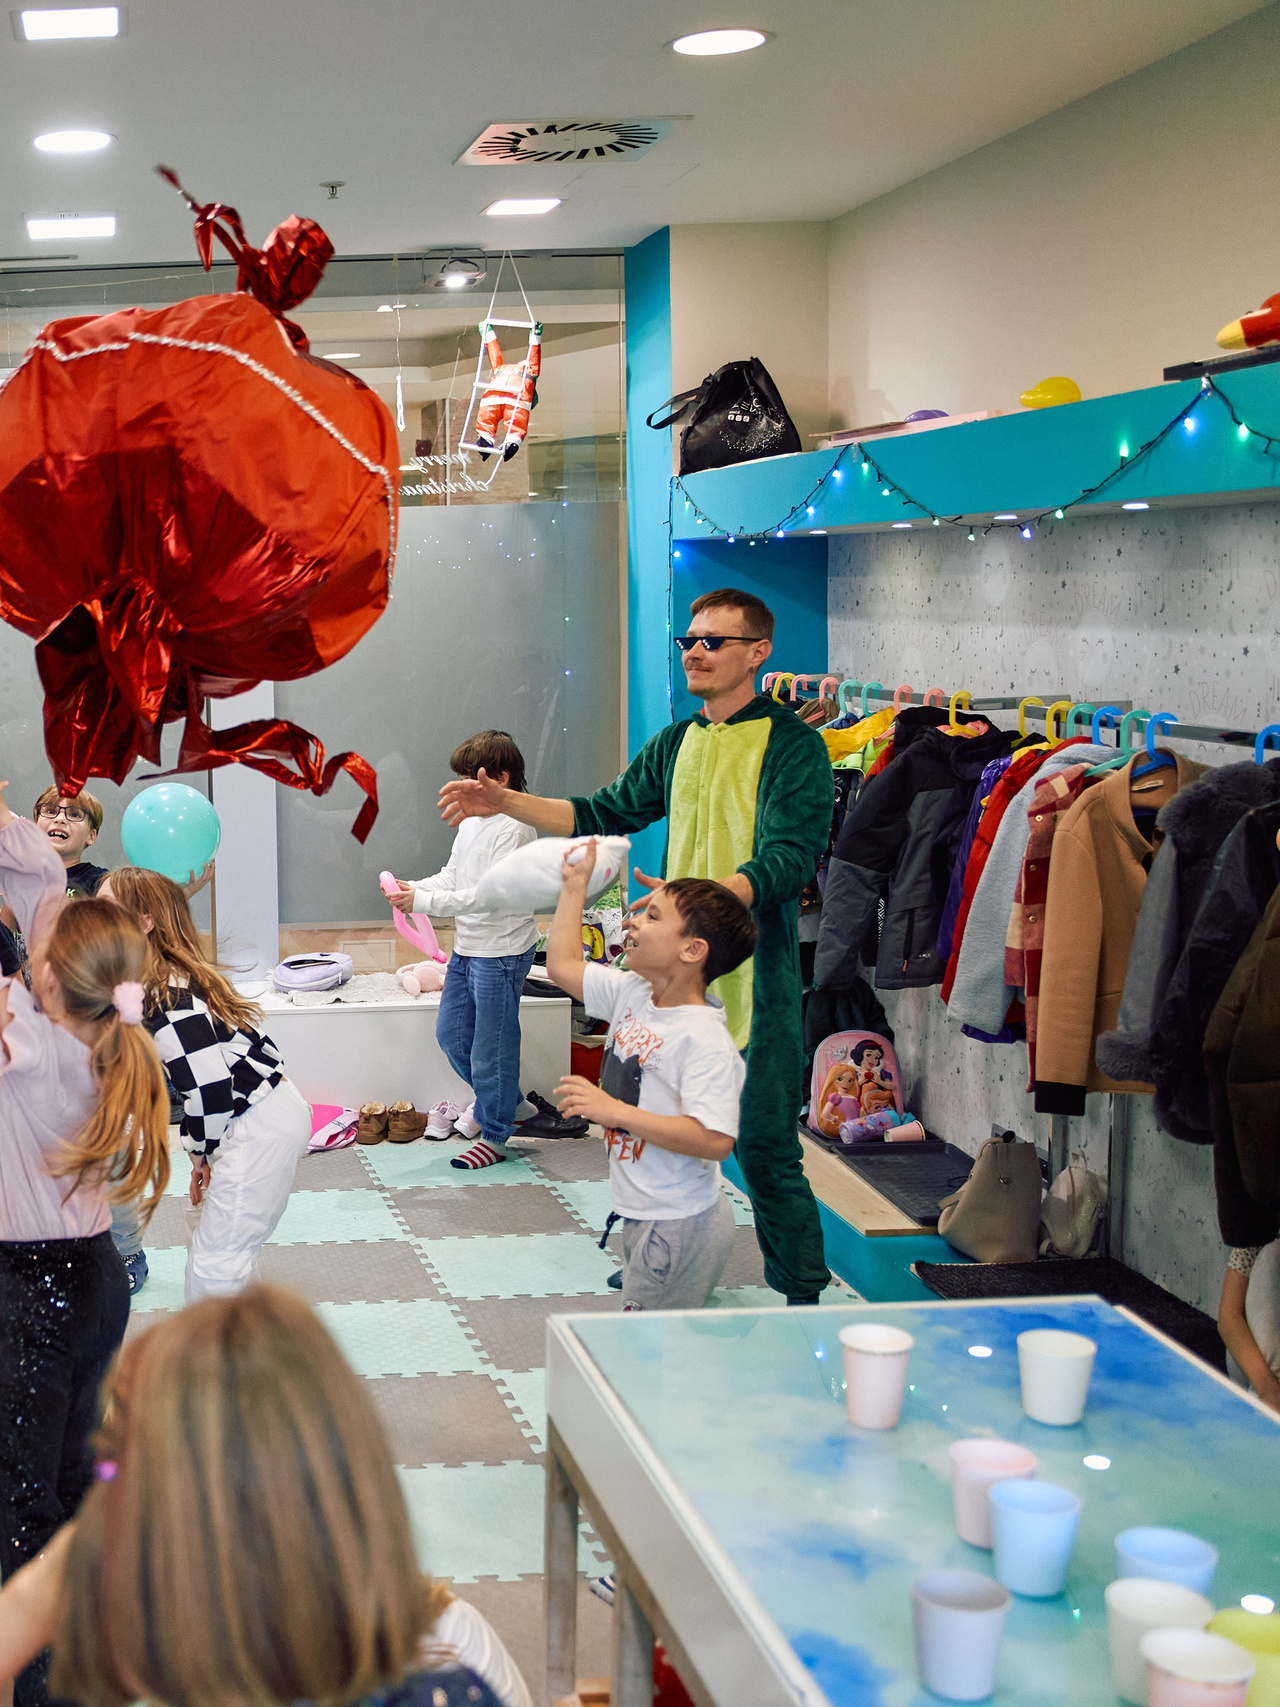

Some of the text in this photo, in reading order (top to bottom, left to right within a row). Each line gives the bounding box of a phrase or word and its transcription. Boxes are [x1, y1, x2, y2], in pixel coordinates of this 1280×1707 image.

[1073, 581, 1122, 619] DREAM
[1022, 610, 1066, 646] DREAM
[1188, 680, 1248, 720] DREAM
